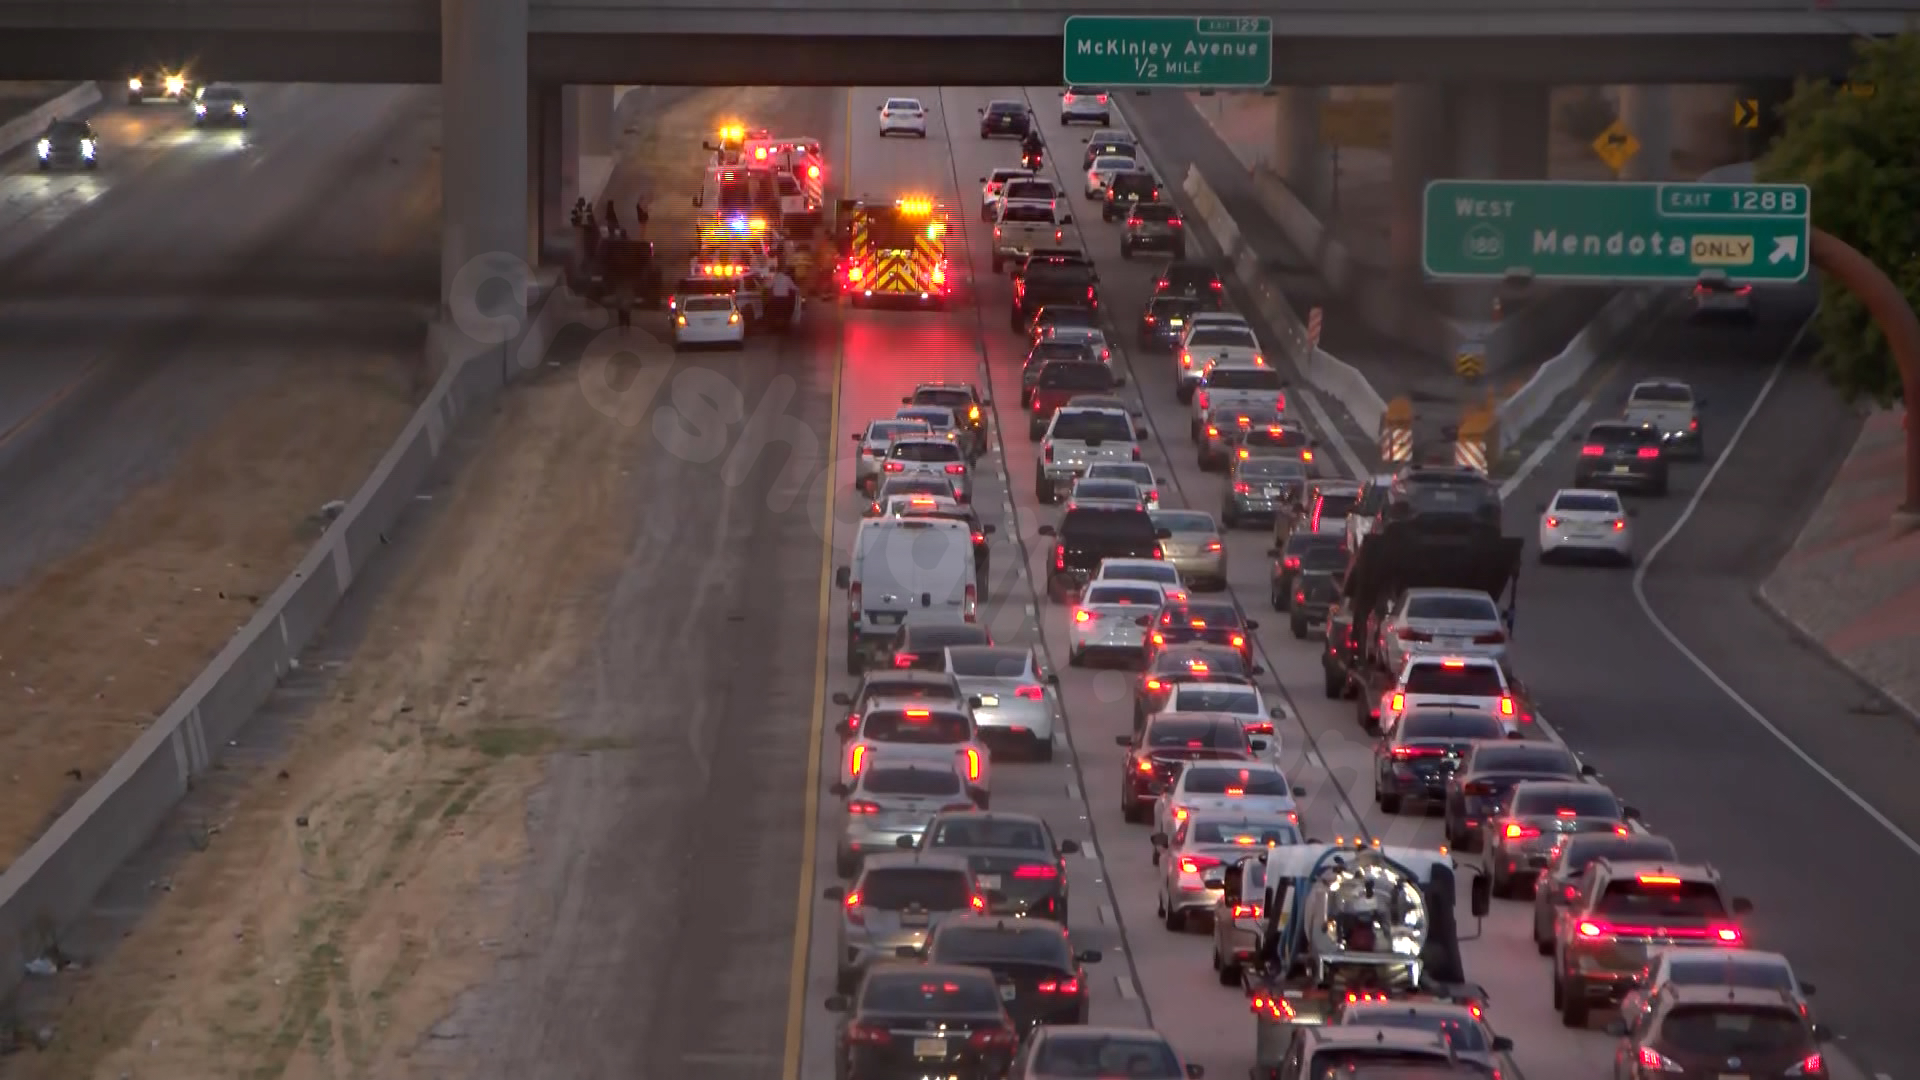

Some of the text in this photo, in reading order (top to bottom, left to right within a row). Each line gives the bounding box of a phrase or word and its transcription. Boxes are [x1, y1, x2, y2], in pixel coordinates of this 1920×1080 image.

[1236, 18, 1259, 32] 129
[1077, 39, 1258, 59] McKinley Avenue
[1165, 61, 1202, 73] MILE
[1670, 192, 1712, 206] EXIT
[1532, 229, 1686, 256] Mendota
[1693, 241, 1752, 258] ONLY
